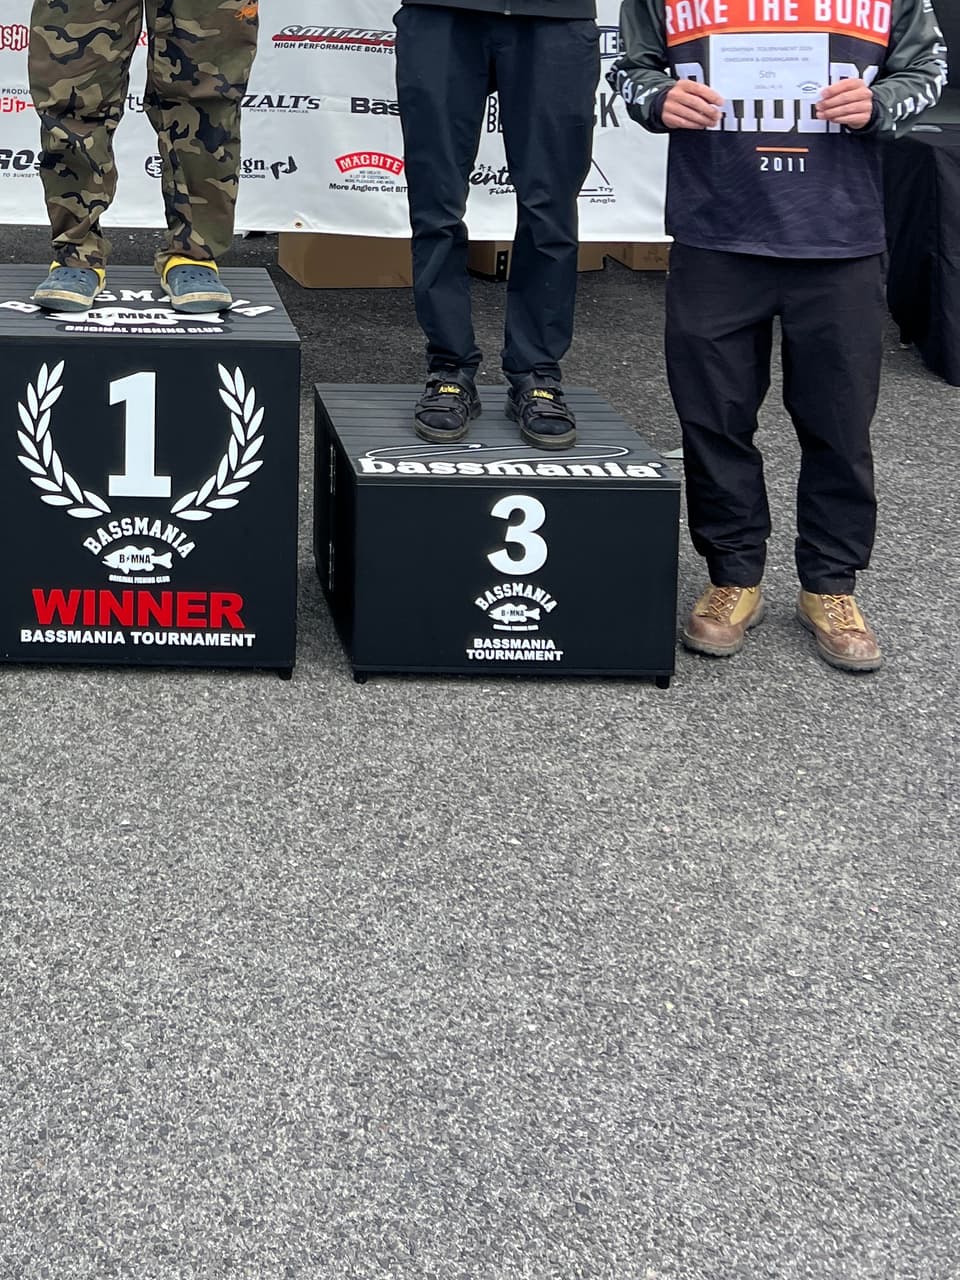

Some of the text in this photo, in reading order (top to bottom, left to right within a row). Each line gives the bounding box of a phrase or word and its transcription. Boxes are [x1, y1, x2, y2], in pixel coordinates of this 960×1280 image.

[274, 41, 394, 55] HIGH PERFORMANCE BOATS
[759, 70, 776, 79] 5th
[340, 153, 402, 172] MAGBITE
[760, 156, 806, 173] 2011
[329, 183, 349, 191] More
[350, 184, 380, 193] Anglers
[380, 185, 394, 193] Get
[64, 325, 224, 334] ORIGINAL FISHING CLUB
[108, 370, 172, 498] 1
[358, 457, 662, 479] bassmania
[82, 516, 196, 559] BASSMANIA
[486, 494, 548, 576] 3
[474, 582, 558, 613] BASSMANIA
[31, 587, 246, 629] WINNER
[20, 628, 256, 648] BASSMANIA TOURNAMENT
[473, 638, 556, 650] BASSMANIA
[466, 649, 564, 661] TOURNAMENT
